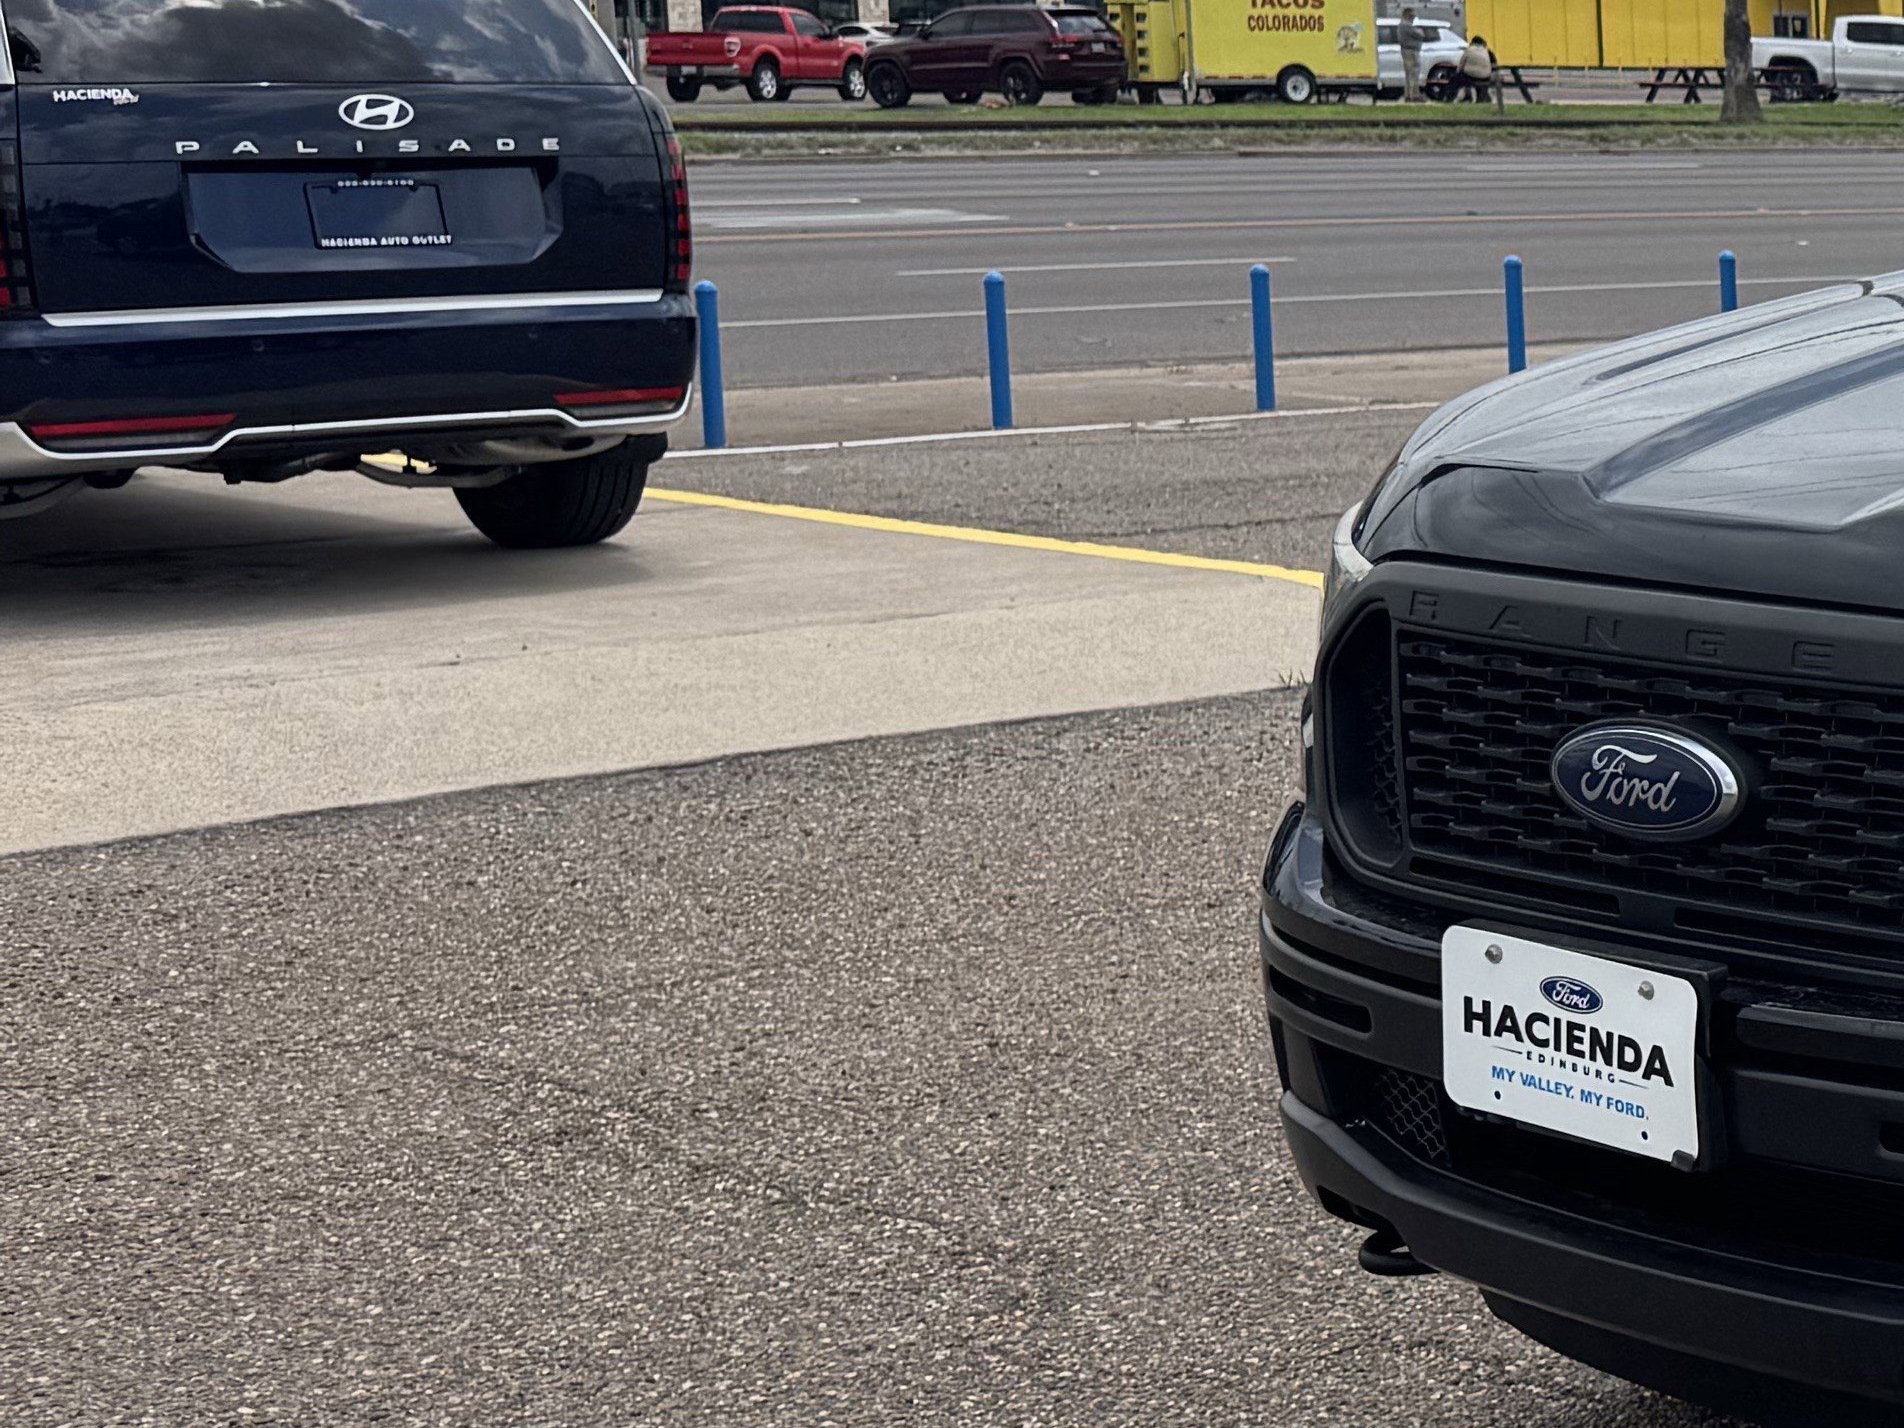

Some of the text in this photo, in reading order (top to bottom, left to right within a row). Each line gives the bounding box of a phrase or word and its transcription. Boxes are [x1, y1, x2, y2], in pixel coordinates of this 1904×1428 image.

[1247, 14, 1325, 32] COLORADOS
[53, 88, 134, 102] HACIENDA
[175, 137, 560, 154] PALISADE
[321, 235, 452, 247] HACIENDA AUTO OUTLET
[1580, 744, 1680, 813] Ford
[1550, 977, 1591, 1009] Ford
[1463, 995, 1675, 1087] HACIENDA
[1526, 1050, 1616, 1084] EDINBURG
[1491, 1065, 1650, 1121] MY VALLEY. MY FORD.
